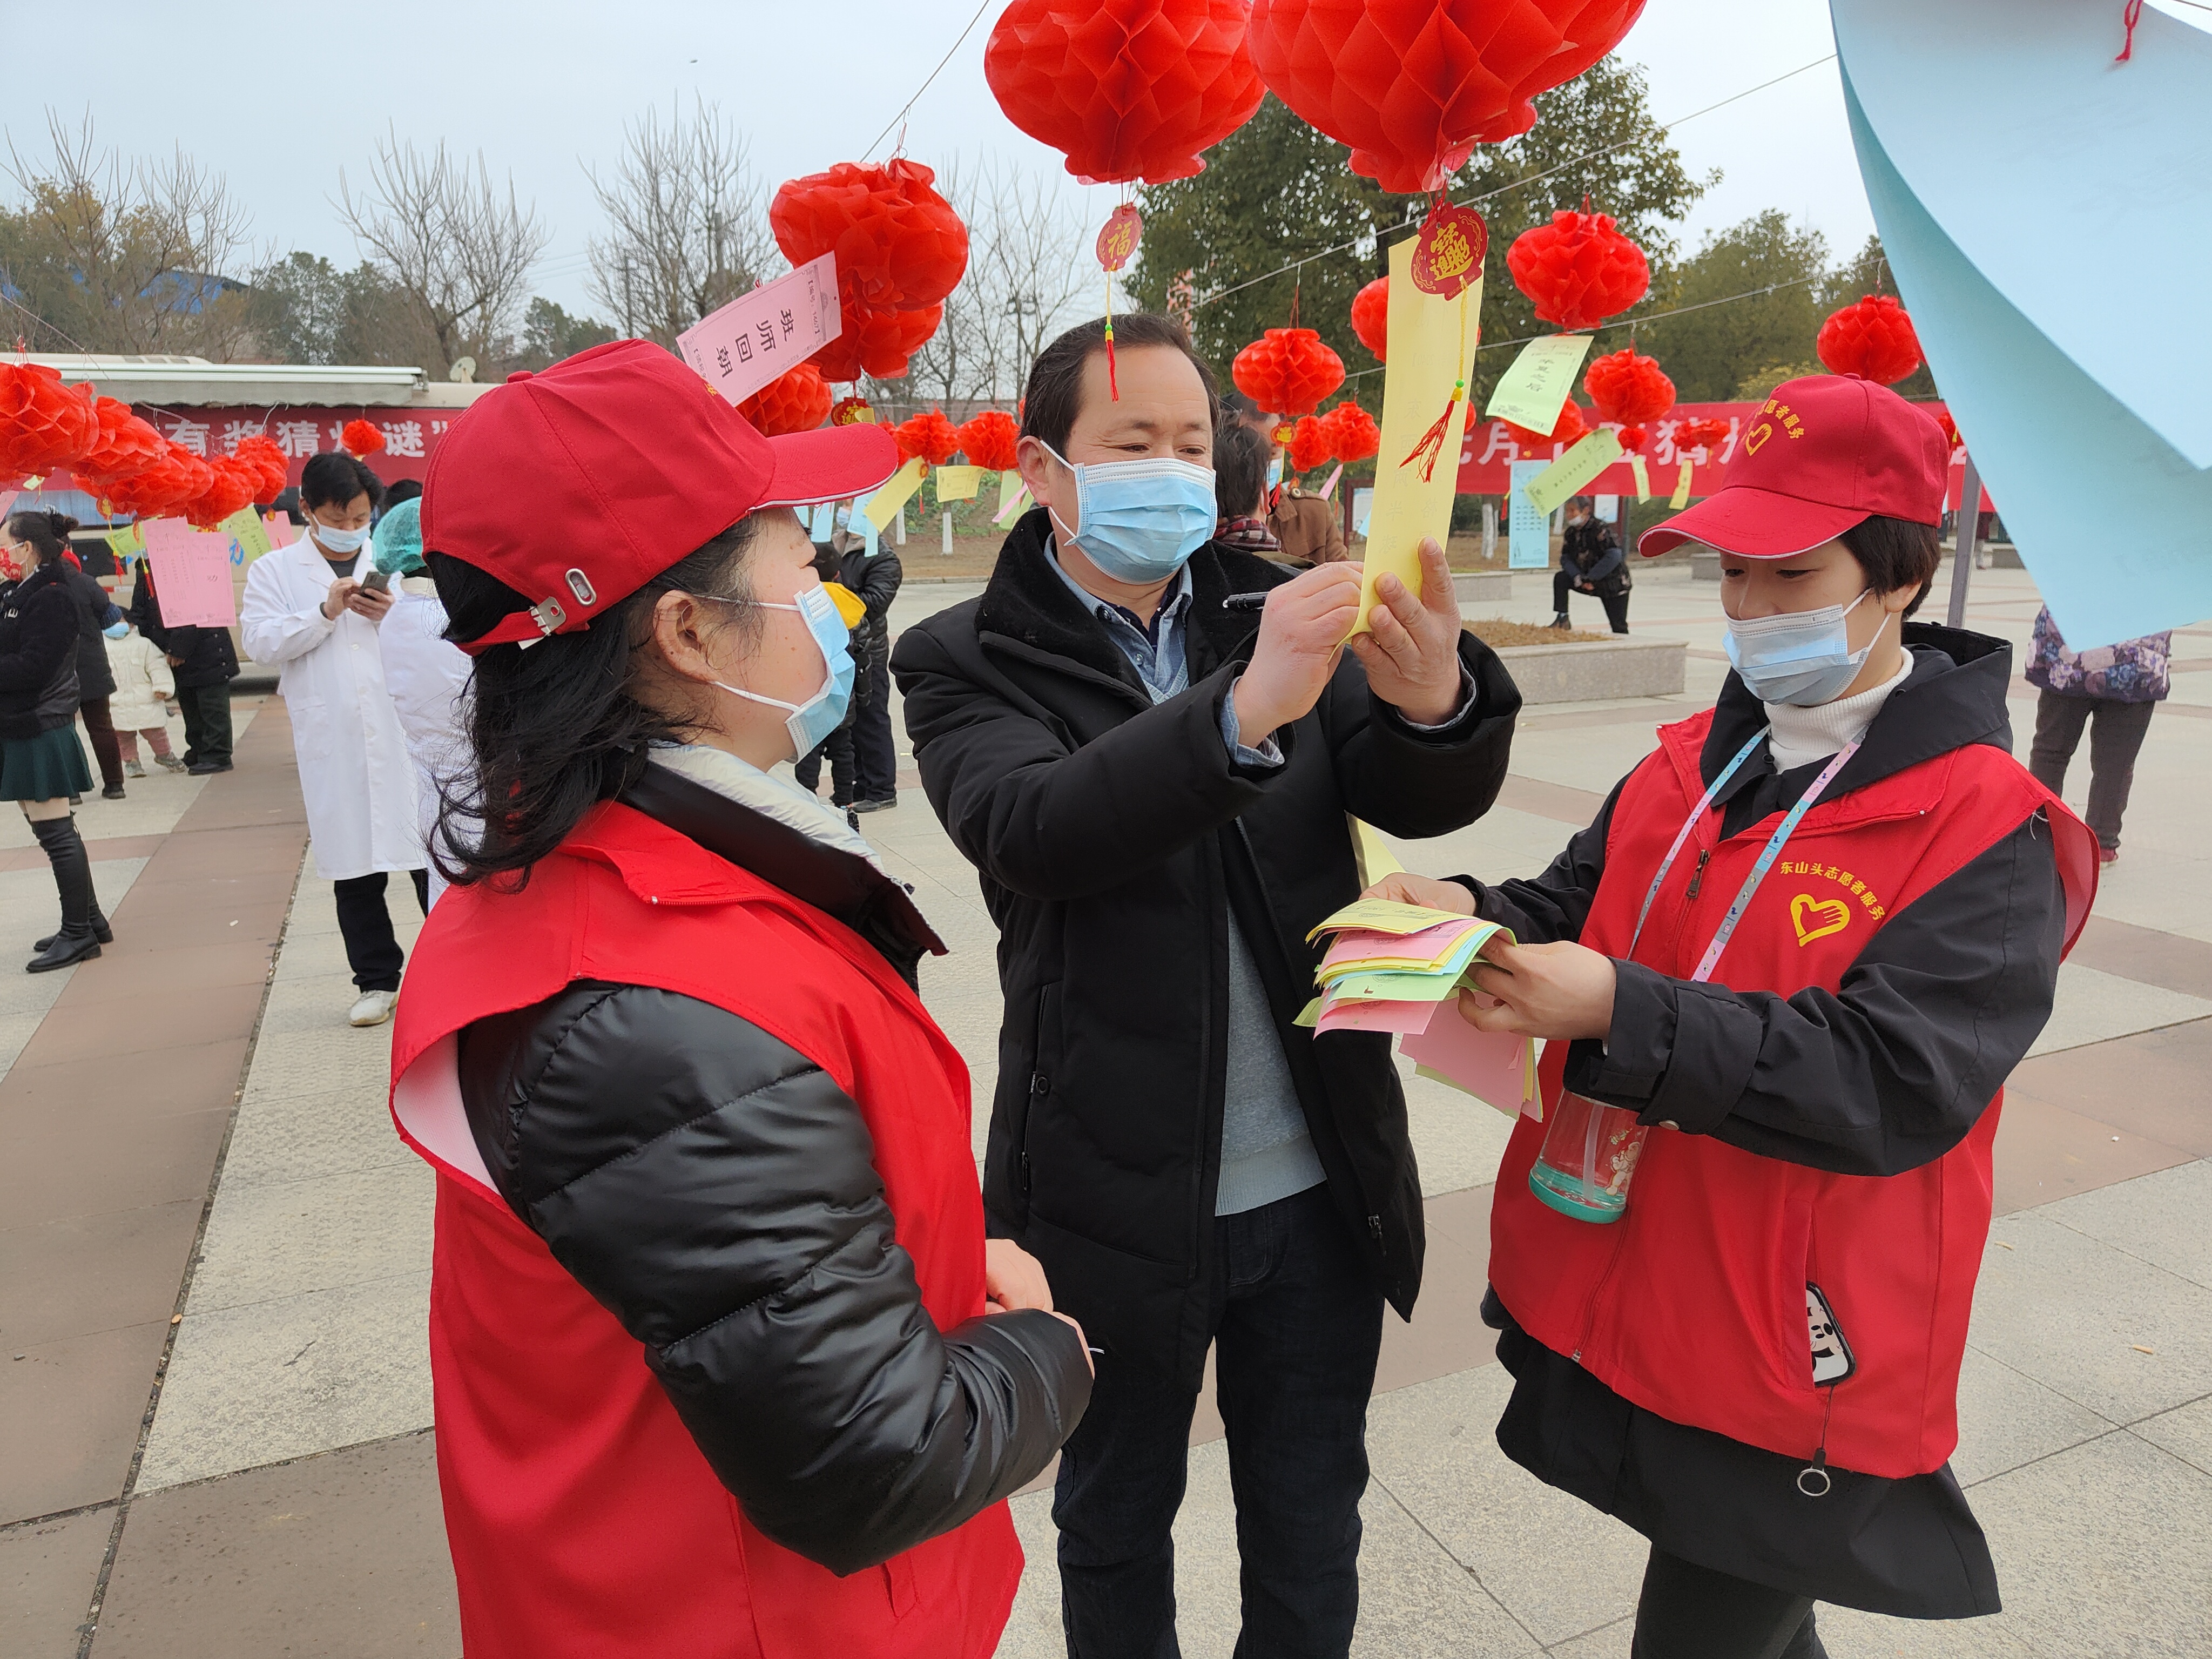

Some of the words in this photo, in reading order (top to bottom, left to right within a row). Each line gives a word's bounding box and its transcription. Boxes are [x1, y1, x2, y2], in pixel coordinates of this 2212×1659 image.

[1108, 220, 1132, 260] 福
[716, 309, 794, 378] 班师回朝
[1780, 861, 1885, 920] 东山头志愿者服务
